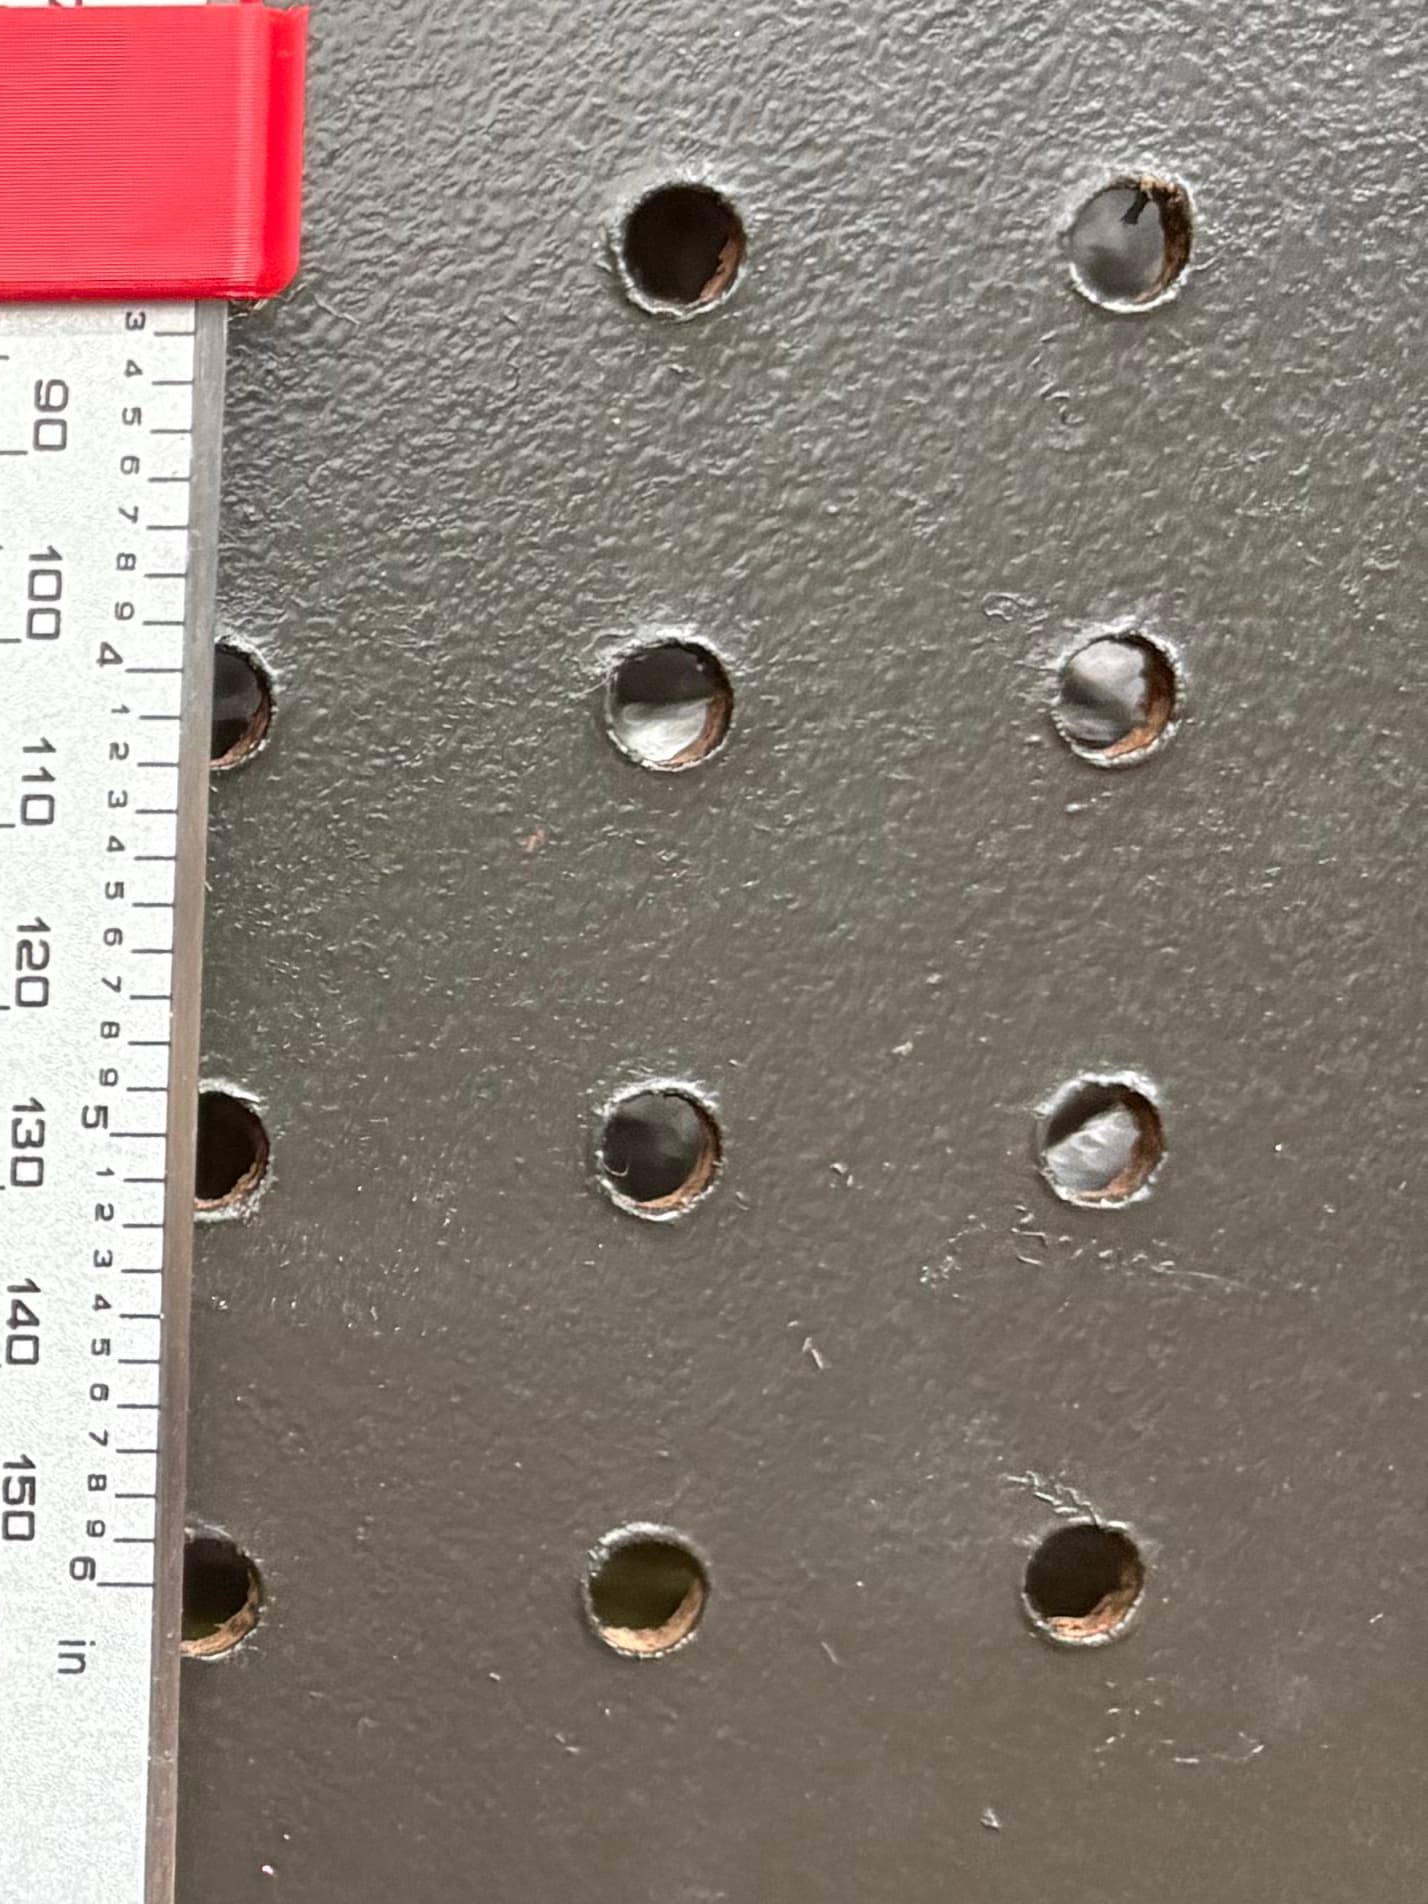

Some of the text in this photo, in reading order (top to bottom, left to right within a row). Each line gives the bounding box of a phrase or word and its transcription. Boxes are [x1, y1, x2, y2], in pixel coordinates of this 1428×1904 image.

[1, 378, 70, 1542] 90 100 110 120 130 140 150
[69, 310, 146, 1582] 3 4 5 6 7 8 9 4 1 2 3 4 5 6 7 8 9 5 1 2 3 4 5 6 7 8 9 6
[57, 1639, 97, 1675] in
